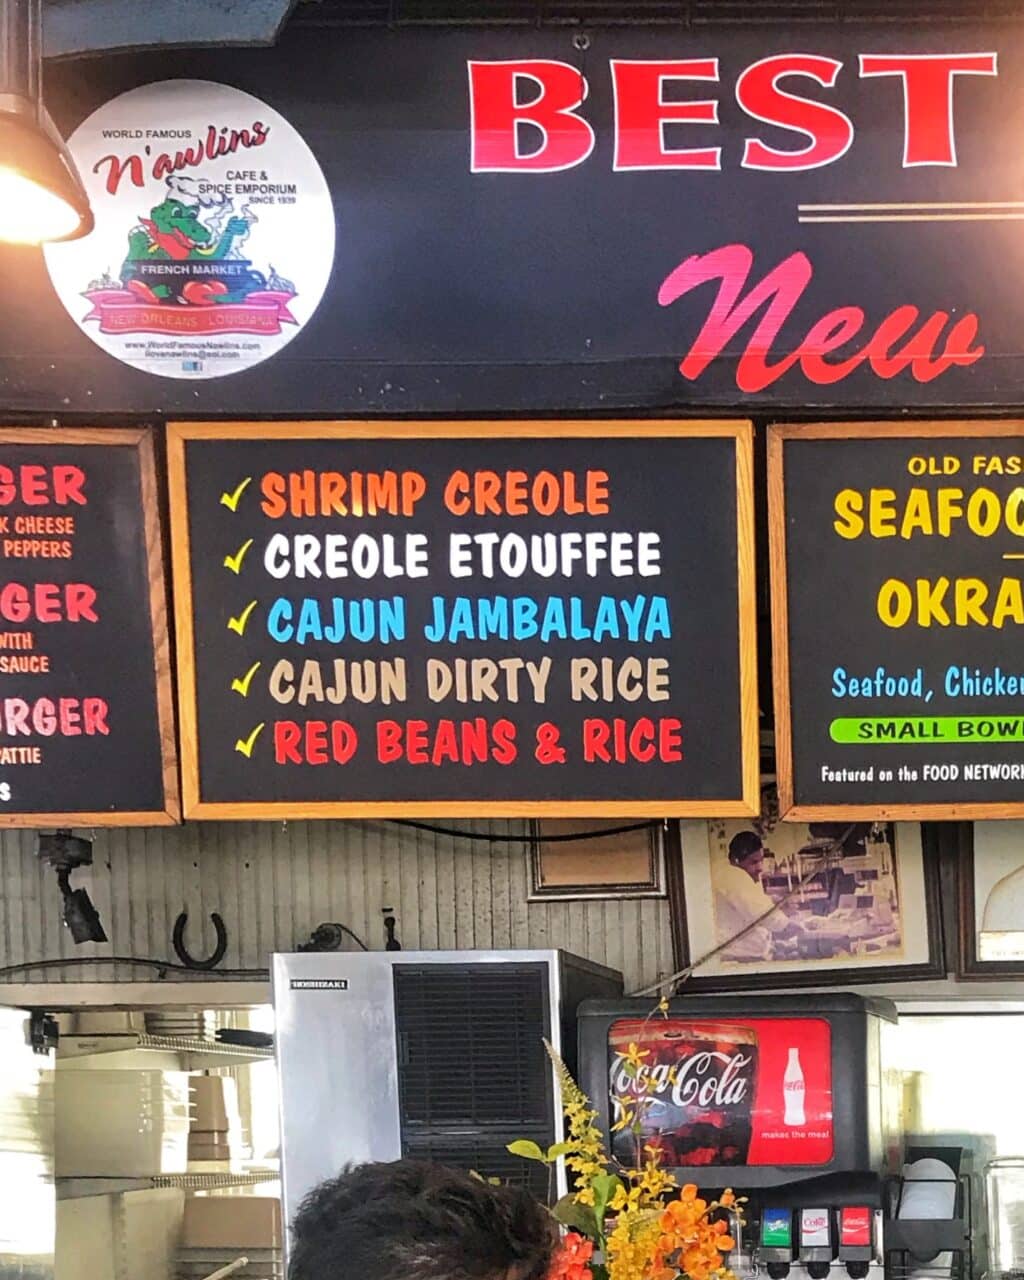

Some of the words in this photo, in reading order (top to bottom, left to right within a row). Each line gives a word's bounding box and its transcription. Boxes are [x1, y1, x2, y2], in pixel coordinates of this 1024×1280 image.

[467, 52, 998, 173] BEST
[102, 130, 143, 139] WORLD
[146, 130, 192, 139] FAMOUS
[226, 171, 256, 181] CAFE
[260, 171, 268, 181] &
[198, 184, 231, 194] SPICE
[235, 184, 297, 194] EMPORIUM
[141, 265, 189, 275] FRENCH
[192, 265, 242, 275] MARKET
[110, 313, 136, 326] NEW
[142, 313, 198, 327] ORLEANS
[657, 243, 984, 393] New
[907, 455, 961, 476] OLD
[260, 469, 427, 519] SHRIMP
[443, 469, 610, 517] CREOLE
[15, 516, 74, 534] CHEESE
[4, 540, 72, 558] PEPPERS
[263, 532, 429, 580] CREOLE
[449, 531, 661, 579] ETOUFFEE
[266, 595, 406, 645] CAJUN
[423, 593, 672, 644] JAMBALAYA
[0, 656, 49, 673] SAUCE
[268, 657, 407, 706] CAJUN
[426, 656, 552, 704] DIRTY
[570, 656, 670, 702] RICE
[831, 666, 933, 703] Seafood,
[0, 698, 110, 736] RGER
[858, 722, 944, 739] SMALL
[273, 719, 359, 766] RED
[375, 717, 518, 767] BEANS
[534, 721, 567, 765] &
[582, 716, 683, 764] RICE
[0, 747, 41, 765] ATTIE
[821, 765, 874, 782] Featured
[878, 770, 893, 782] on
[897, 765, 918, 782] the
[923, 764, 959, 781] FOOD
[609, 1051, 752, 1107] CocaCola
